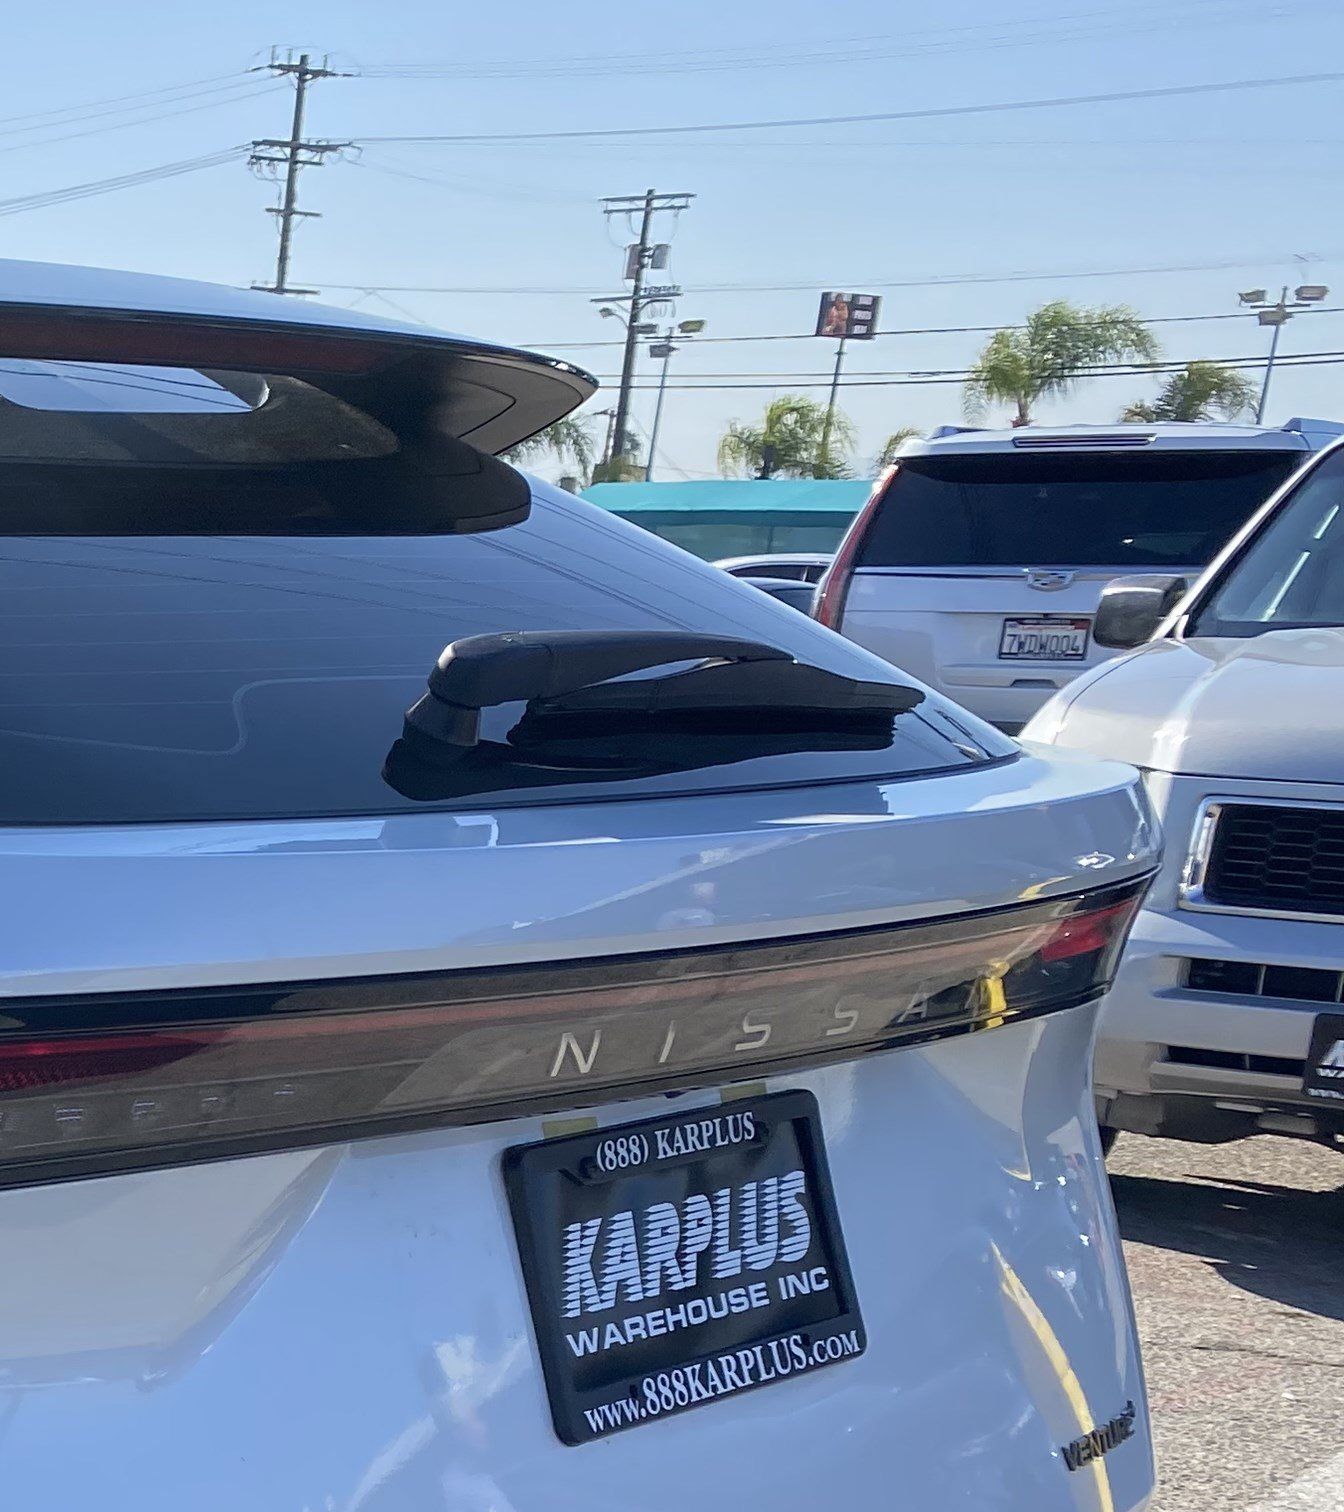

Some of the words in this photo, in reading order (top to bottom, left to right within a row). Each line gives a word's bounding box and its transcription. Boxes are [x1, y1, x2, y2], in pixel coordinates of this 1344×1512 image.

[595, 1133, 649, 1172] (888)
[655, 1111, 756, 1160] KARPLUS
[560, 1170, 813, 1319] KARPLUS
[566, 1288, 770, 1358] WAREHOUSE
[779, 1266, 830, 1303] INC
